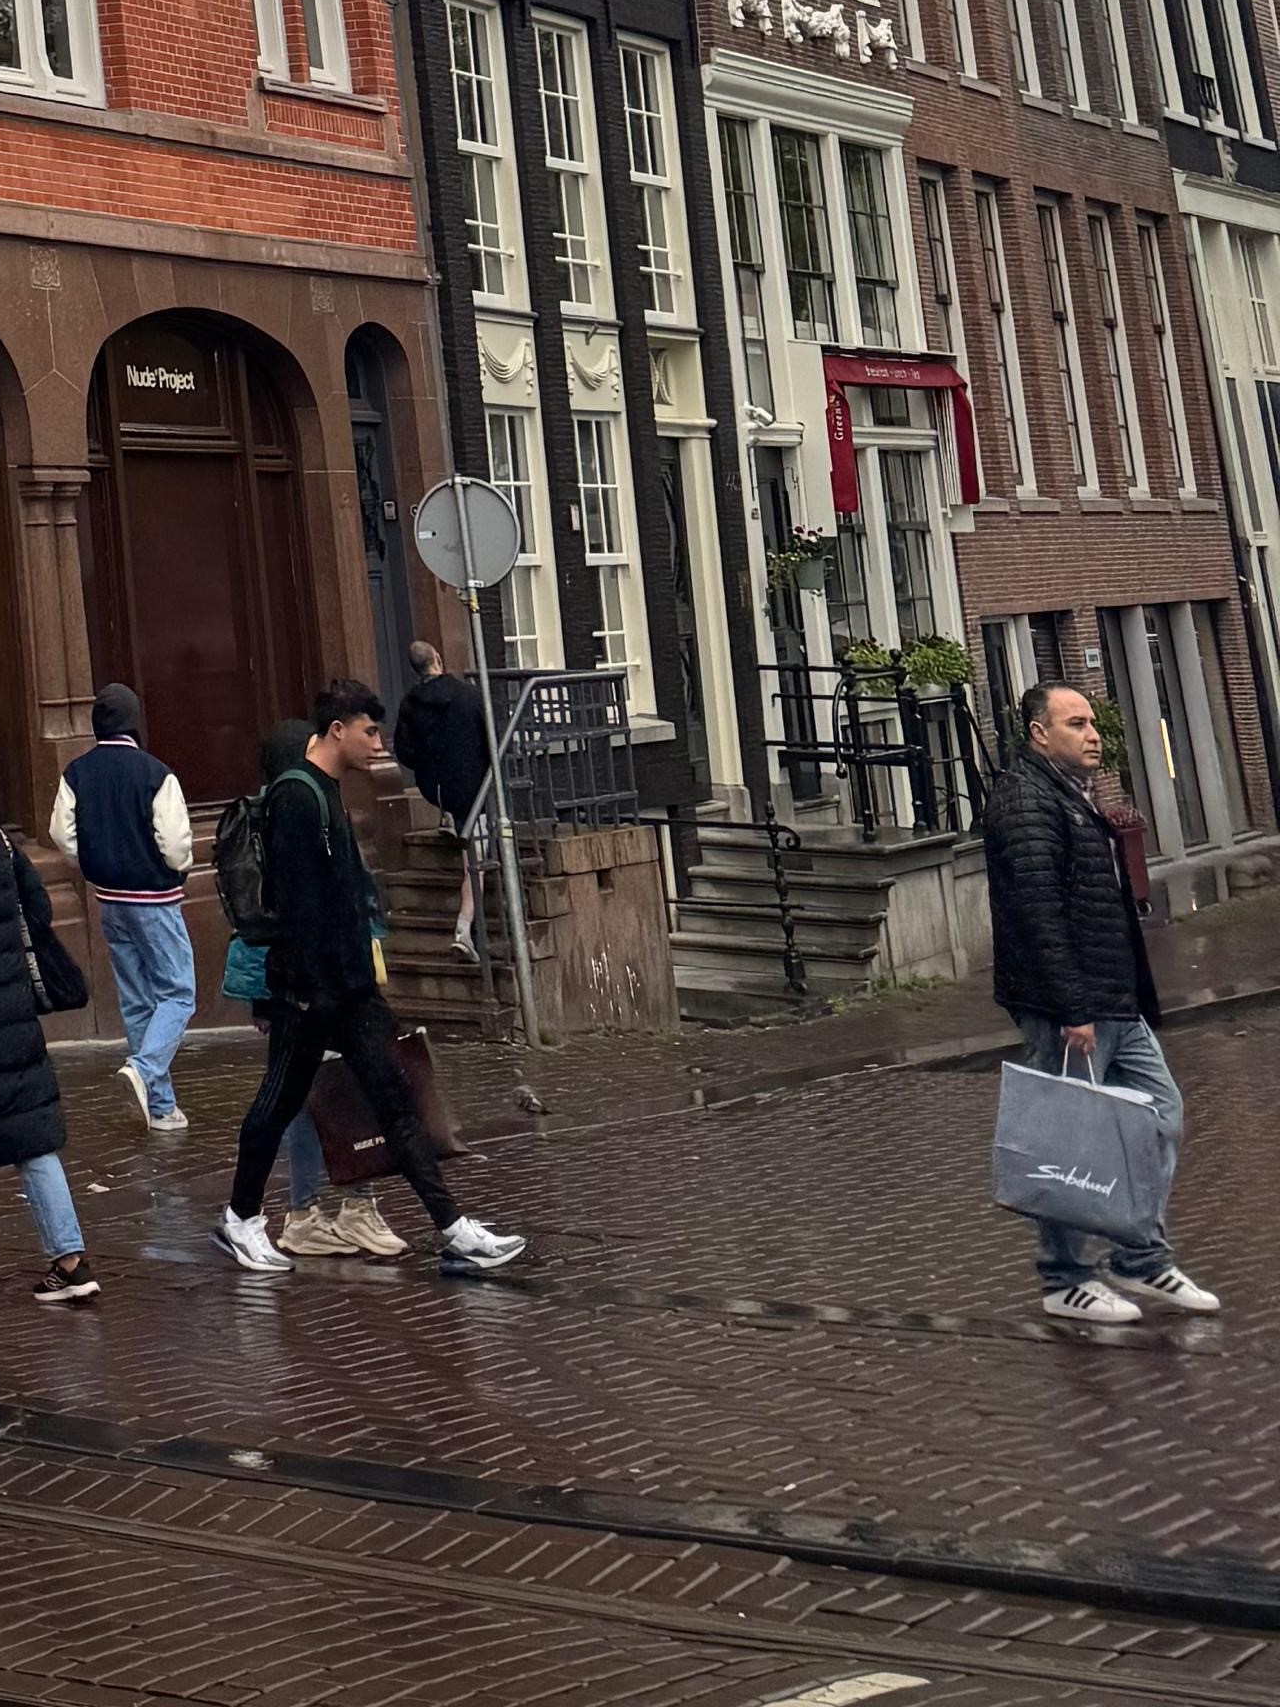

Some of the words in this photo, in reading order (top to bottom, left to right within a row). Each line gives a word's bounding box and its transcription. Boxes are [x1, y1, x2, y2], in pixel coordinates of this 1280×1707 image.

[126, 364, 157, 388] Nude
[158, 367, 195, 394] Project
[1026, 1164, 1118, 1198] Subdued
